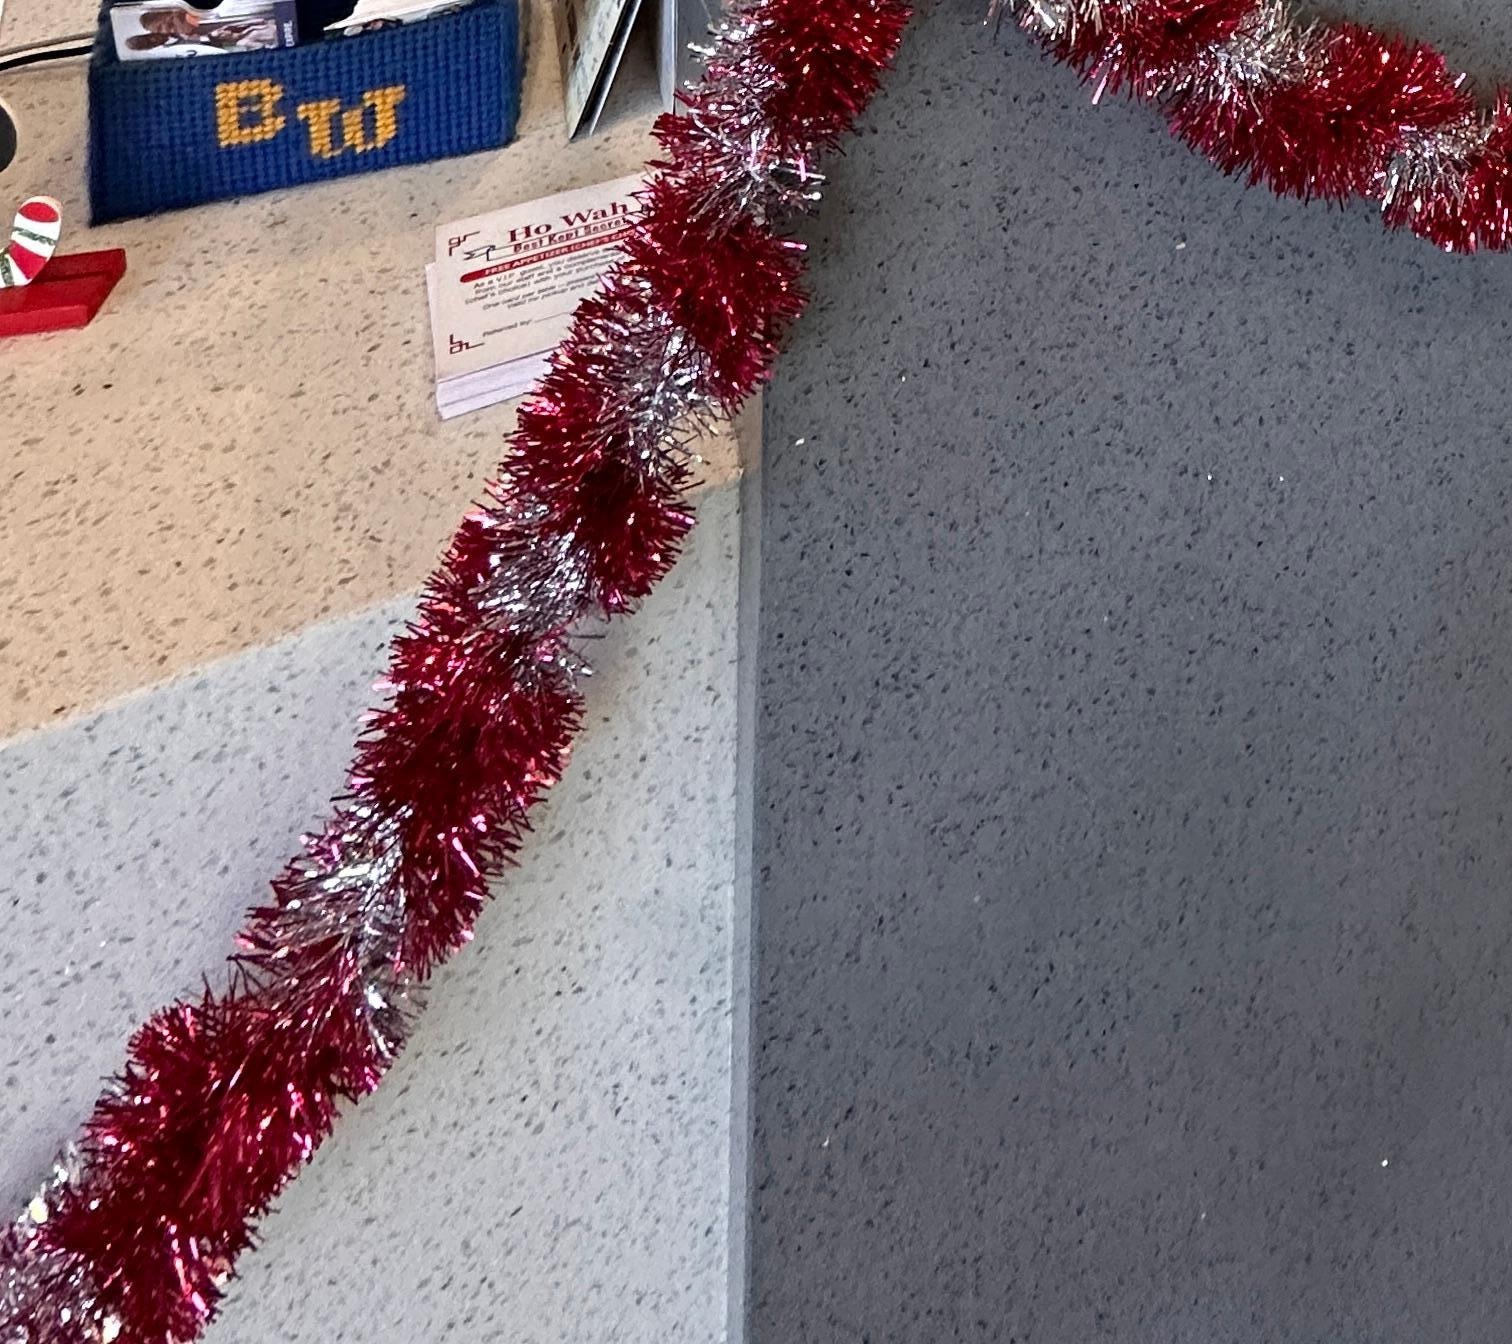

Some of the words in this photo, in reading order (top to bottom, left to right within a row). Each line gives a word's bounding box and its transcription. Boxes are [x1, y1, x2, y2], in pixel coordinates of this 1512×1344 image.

[215, 78, 406, 159] BW
[508, 223, 552, 243] Ho
[560, 202, 629, 227] Wah
[513, 238, 544, 255] Best
[548, 229, 580, 245] Kept
[584, 216, 628, 235] Secret
[484, 263, 512, 276] FREE
[515, 247, 570, 269] APPETIZER
